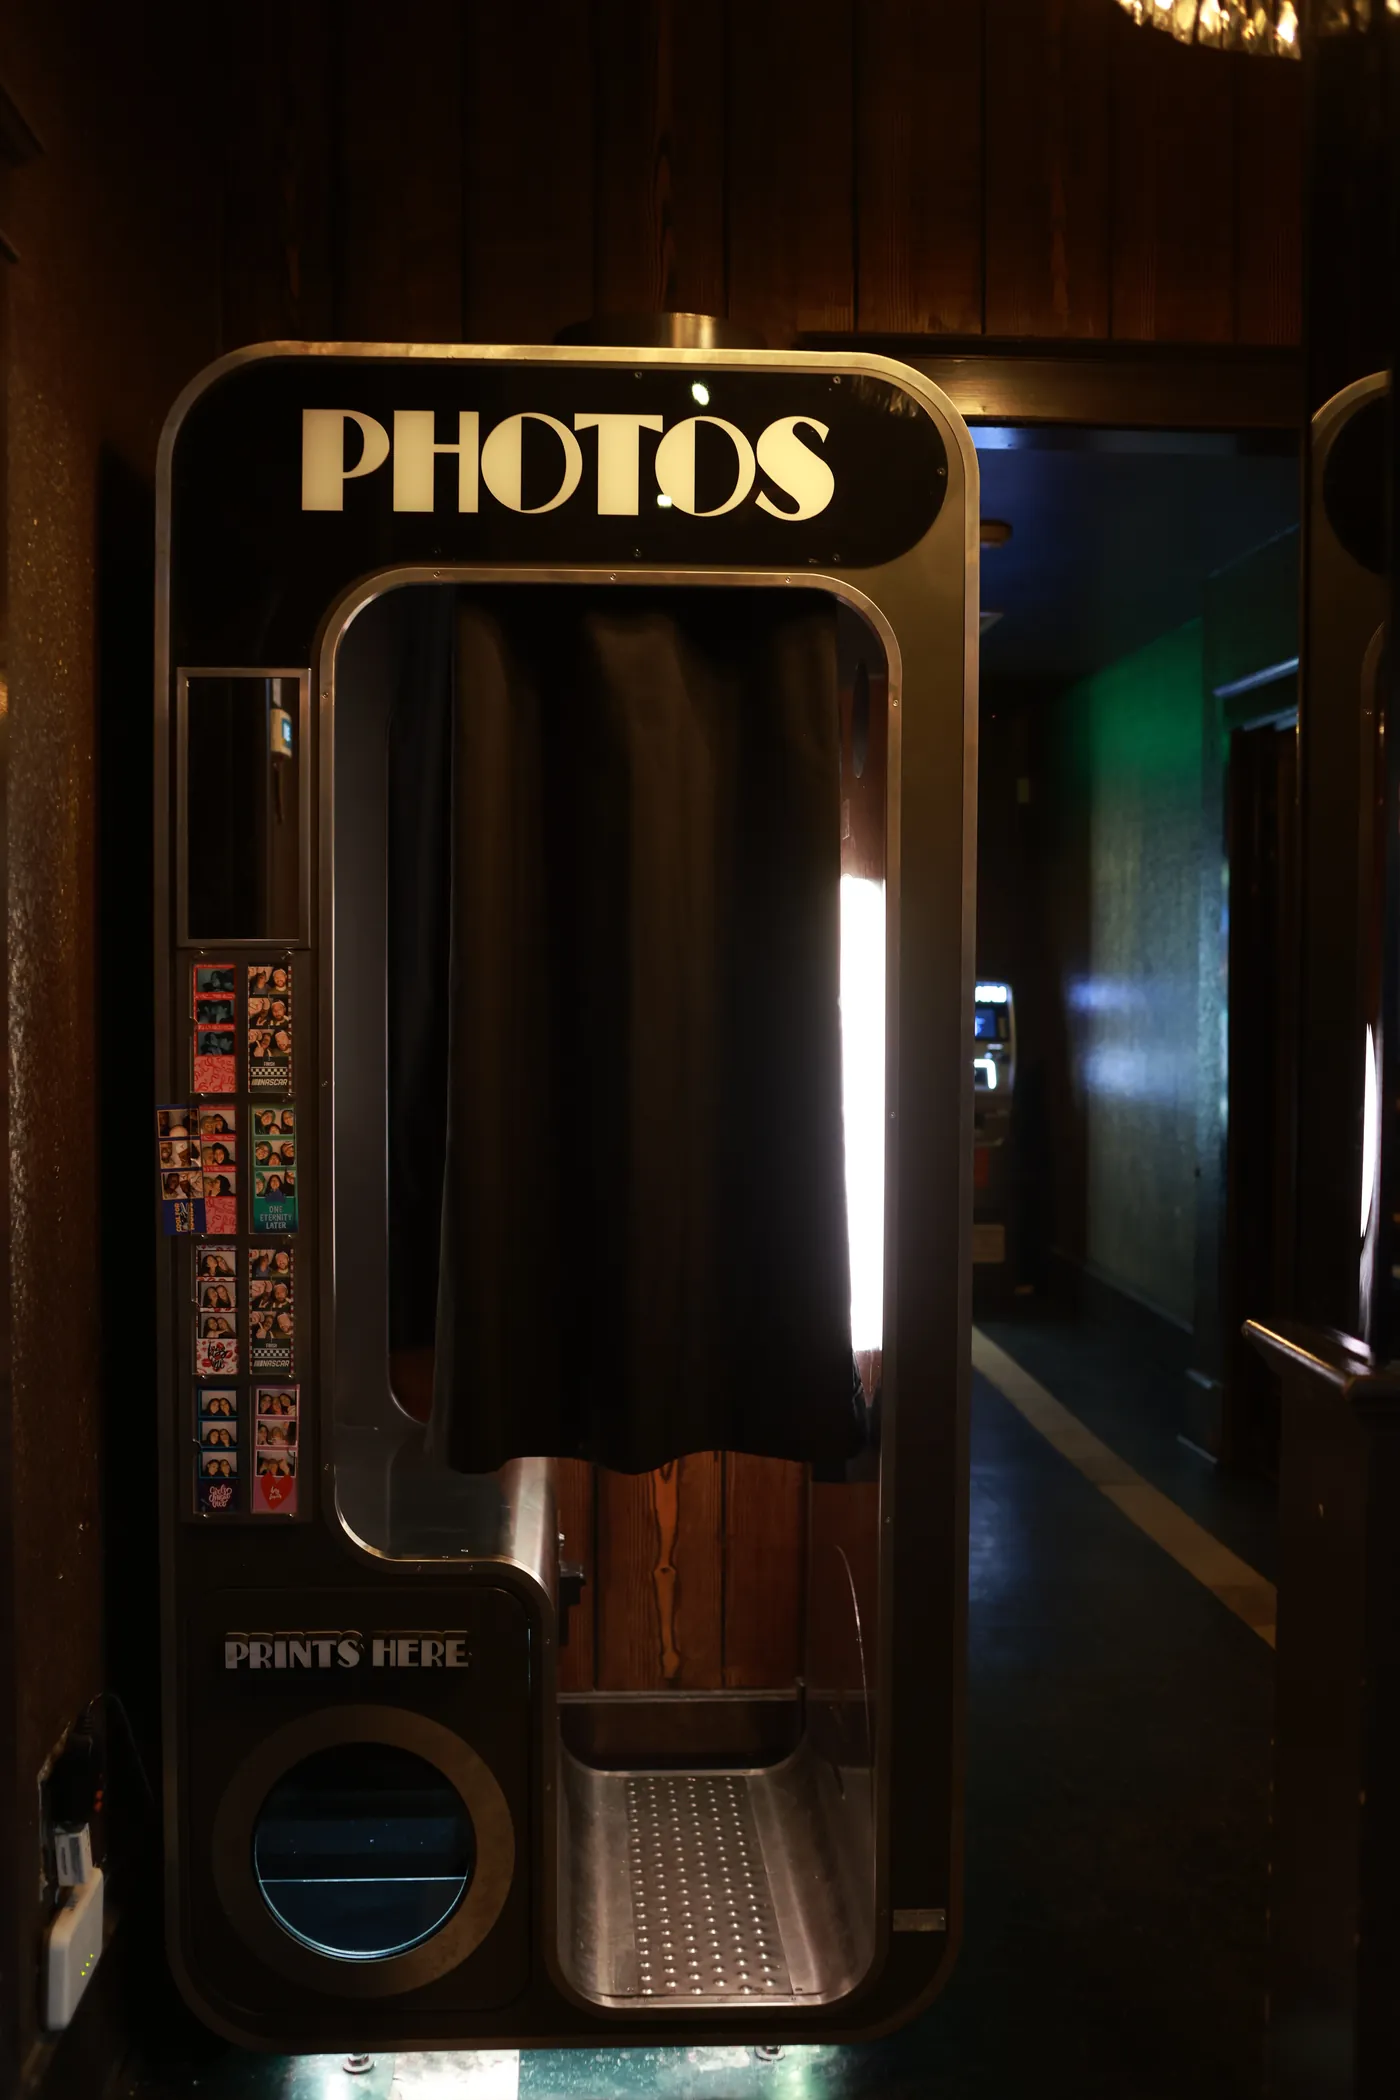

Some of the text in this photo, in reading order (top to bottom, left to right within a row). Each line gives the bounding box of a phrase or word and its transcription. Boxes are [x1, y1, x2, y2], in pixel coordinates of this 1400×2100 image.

[301, 408, 835, 522] PHOTOS
[260, 1078, 288, 1086] NASCAR
[268, 1205, 284, 1213] ONE
[259, 1213, 292, 1222] ETERNITY
[265, 1222, 287, 1230] LATER
[224, 1637, 469, 1669] PRINTS HERE
